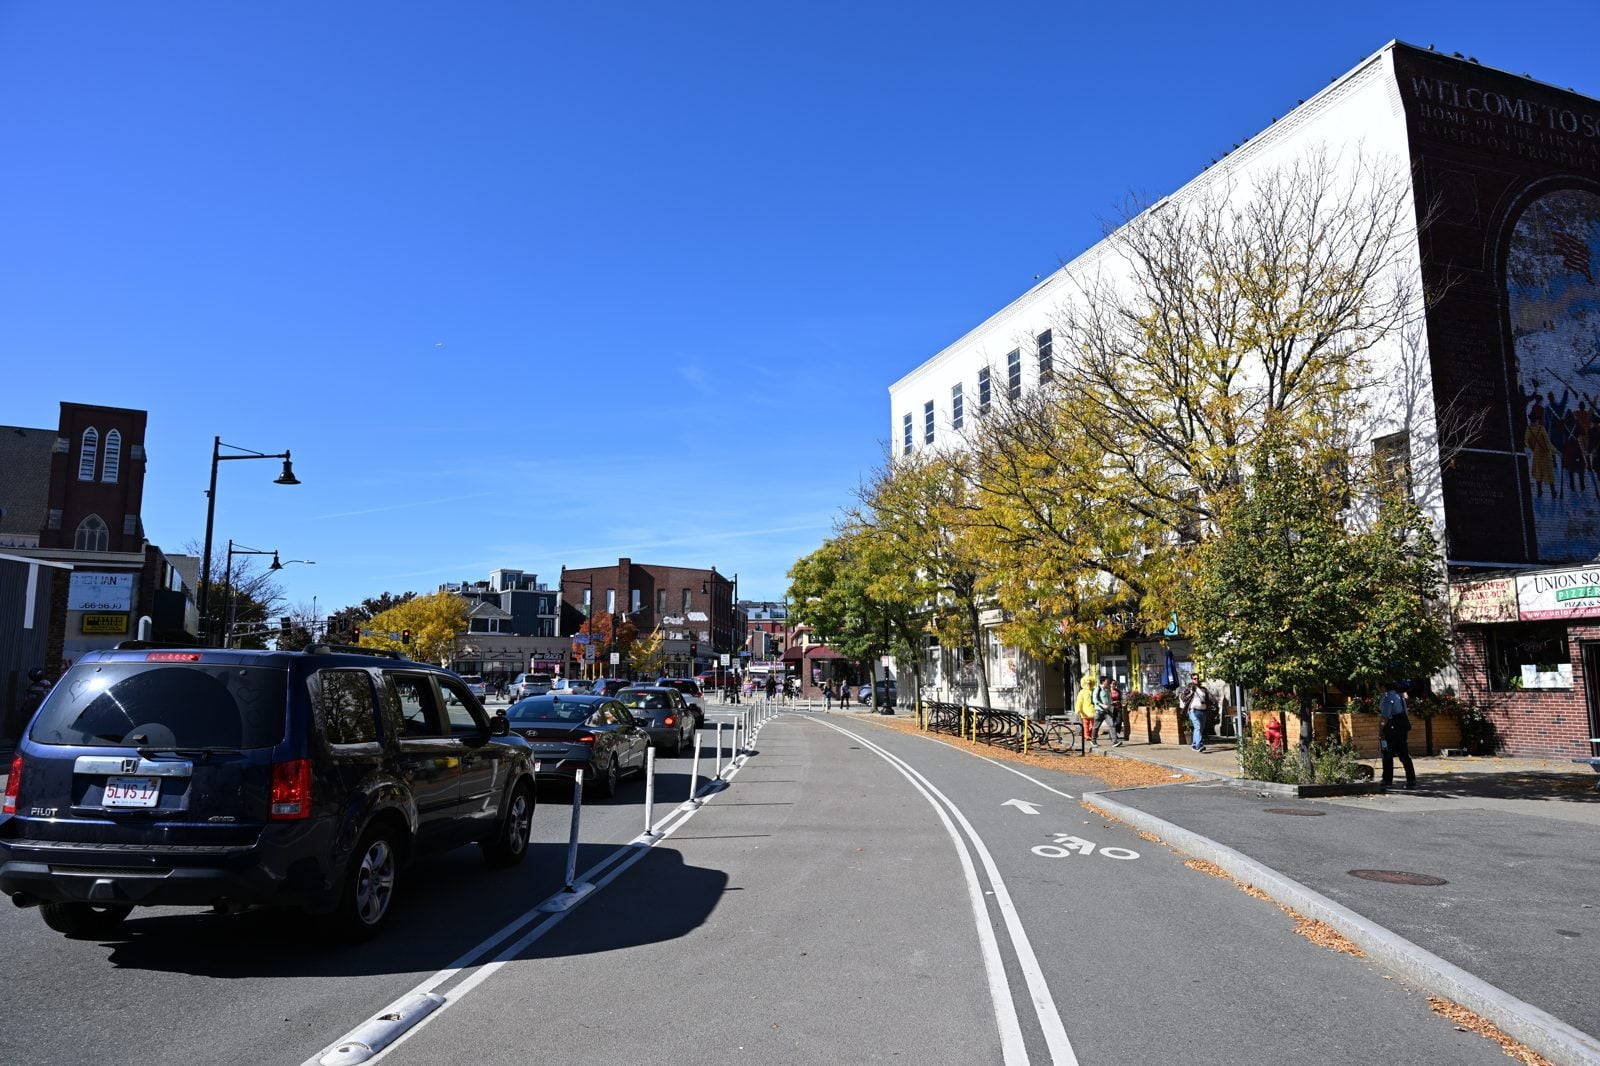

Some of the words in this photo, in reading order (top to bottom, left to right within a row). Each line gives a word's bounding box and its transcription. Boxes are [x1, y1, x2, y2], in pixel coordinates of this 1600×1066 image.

[1411, 76, 1538, 124] WELCOME
[1541, 104, 1577, 133] TO
[1420, 103, 1469, 126] HOME
[1534, 574, 1577, 593] UNION
[1581, 572, 1600, 585] SQ
[107, 784, 138, 799] 5LVS
[140, 784, 157, 799] 17
[31, 807, 58, 816] PILOT
